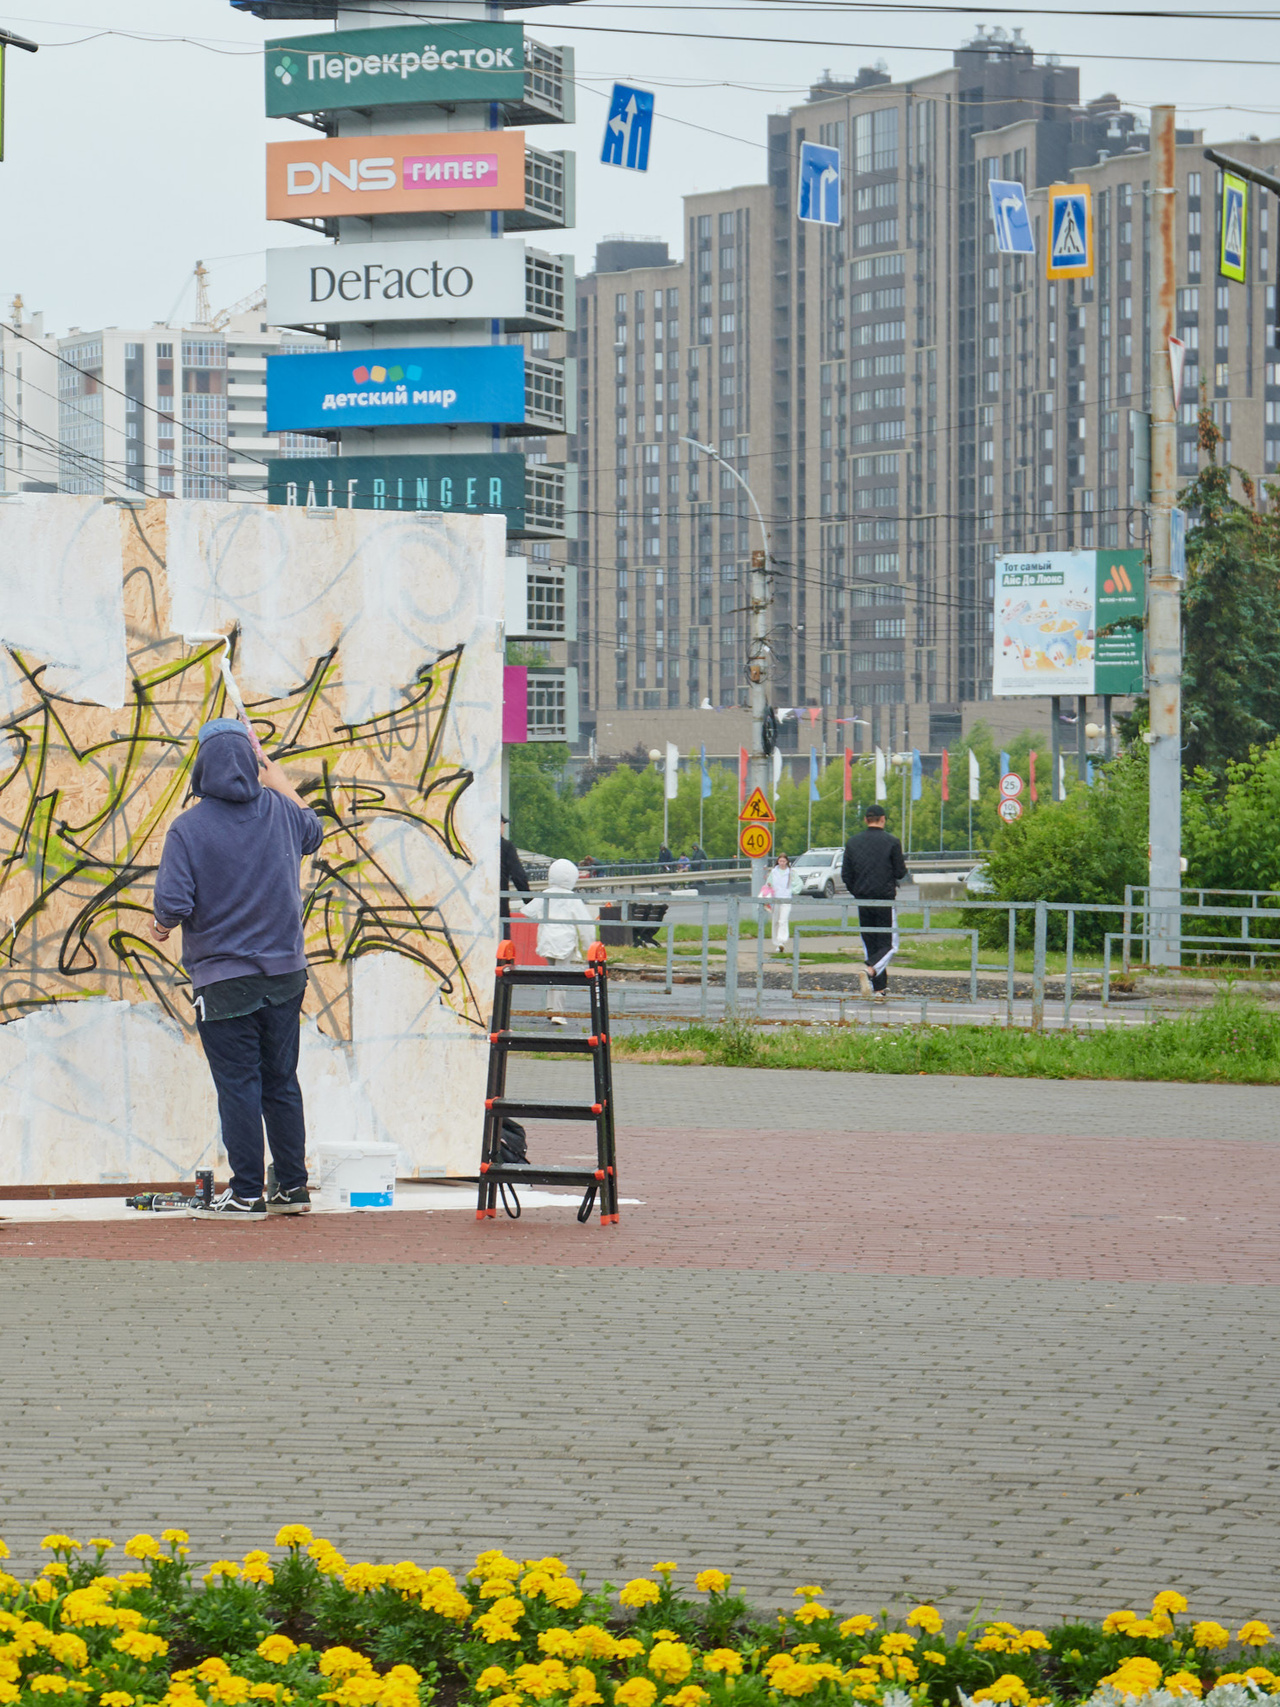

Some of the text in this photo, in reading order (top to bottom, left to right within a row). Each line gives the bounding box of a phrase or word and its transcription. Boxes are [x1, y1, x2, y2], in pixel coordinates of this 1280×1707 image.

[307, 45, 514, 84] Перекрёсток
[286, 157, 397, 196] DNS
[411, 160, 490, 182] ГИПЕР
[310, 260, 474, 303] DeFacto
[322, 385, 457, 410] детский мир
[373, 476, 503, 509] RINGER
[1004, 561, 1052, 571] Тот самый
[1003, 574, 1063, 586] Айс Де Люкс
[746, 834, 765, 848] 40
